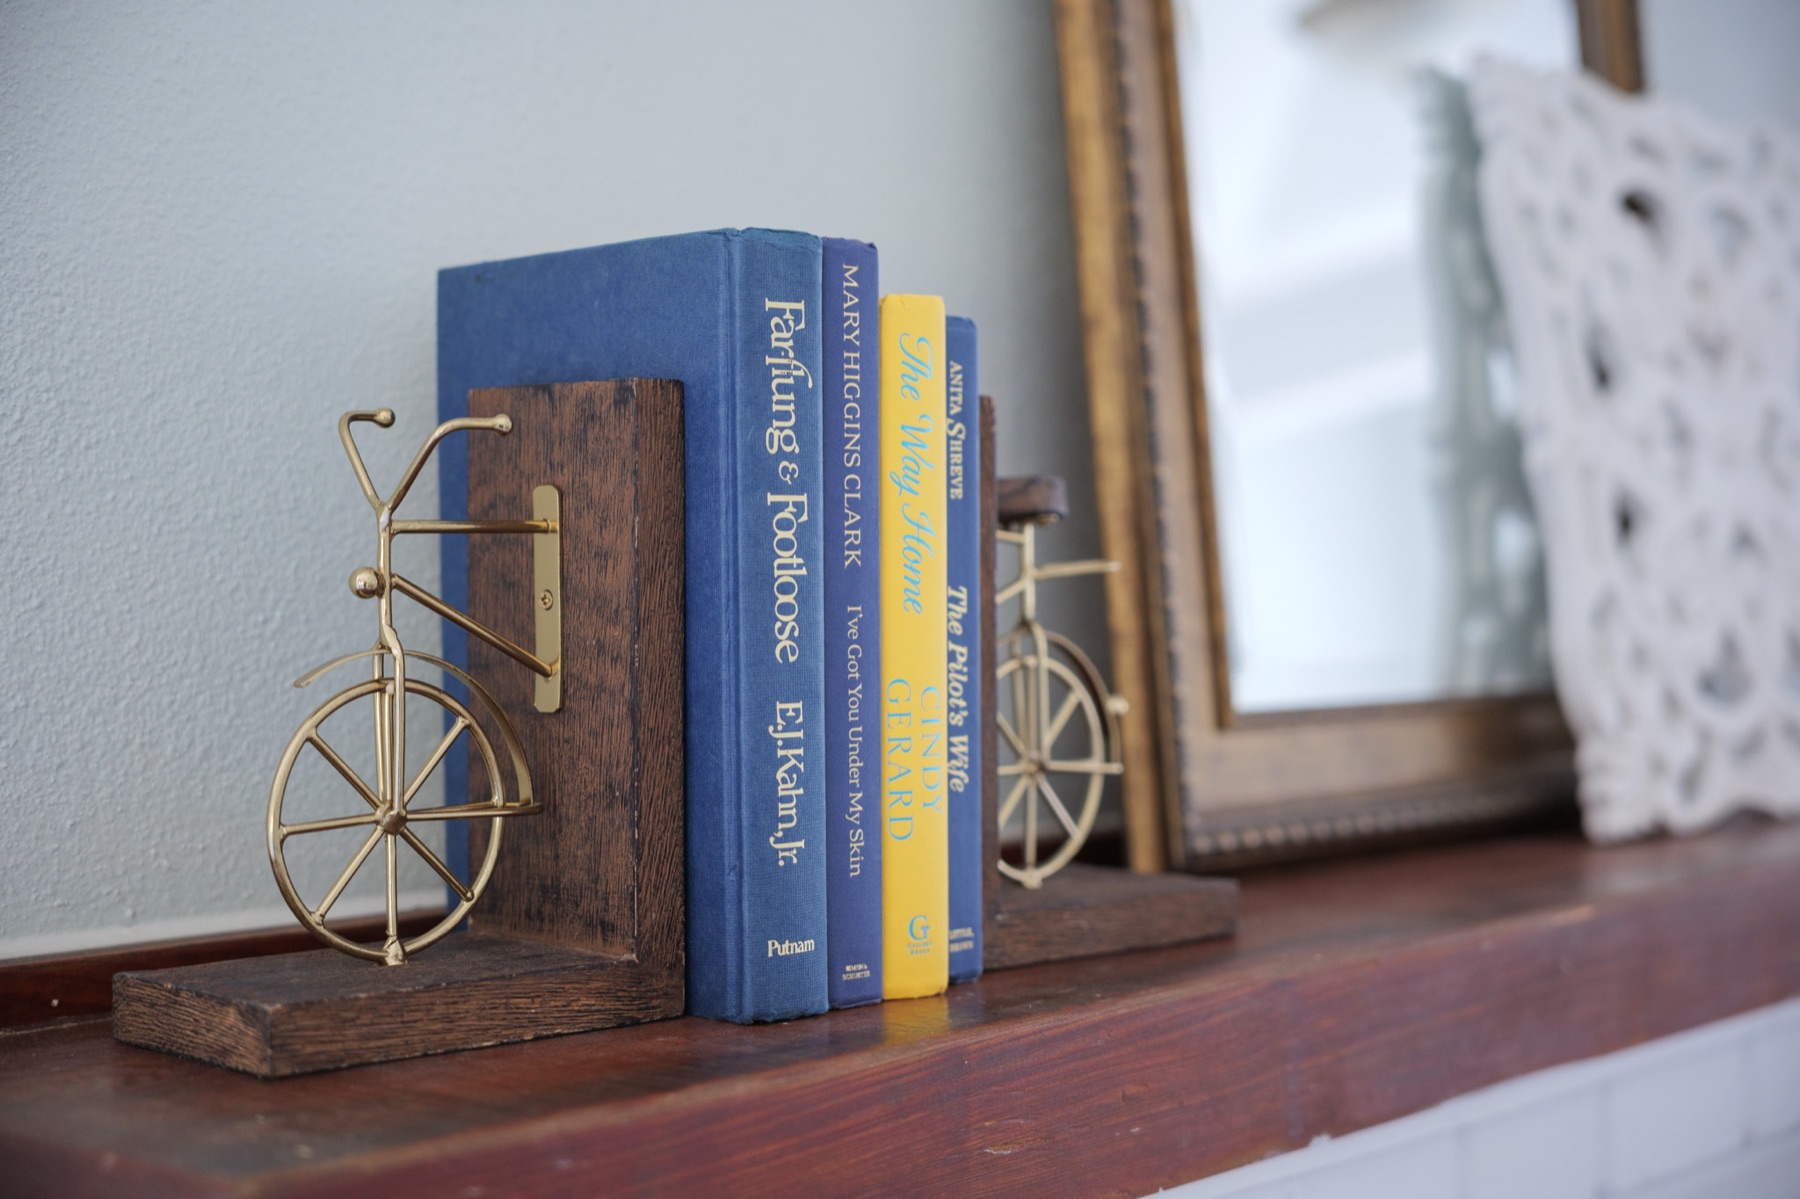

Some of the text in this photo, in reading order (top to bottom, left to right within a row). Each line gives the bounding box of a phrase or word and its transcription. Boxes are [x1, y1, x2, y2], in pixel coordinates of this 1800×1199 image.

[778, 461, 799, 485] &
[842, 264, 861, 569] MARY HIGGINS CLARK
[889, 333, 936, 614] The Way Home
[946, 360, 966, 499] ANITA SHREVE
[767, 492, 808, 664] Footloose
[845, 605, 864, 877] I've Got You Under My Skin
[886, 678, 914, 841] GERARD
[920, 686, 942, 814] CINDY
[947, 585, 969, 793] The Pilot's Wife
[767, 939, 815, 957] Putnam
[908, 915, 930, 941] G
